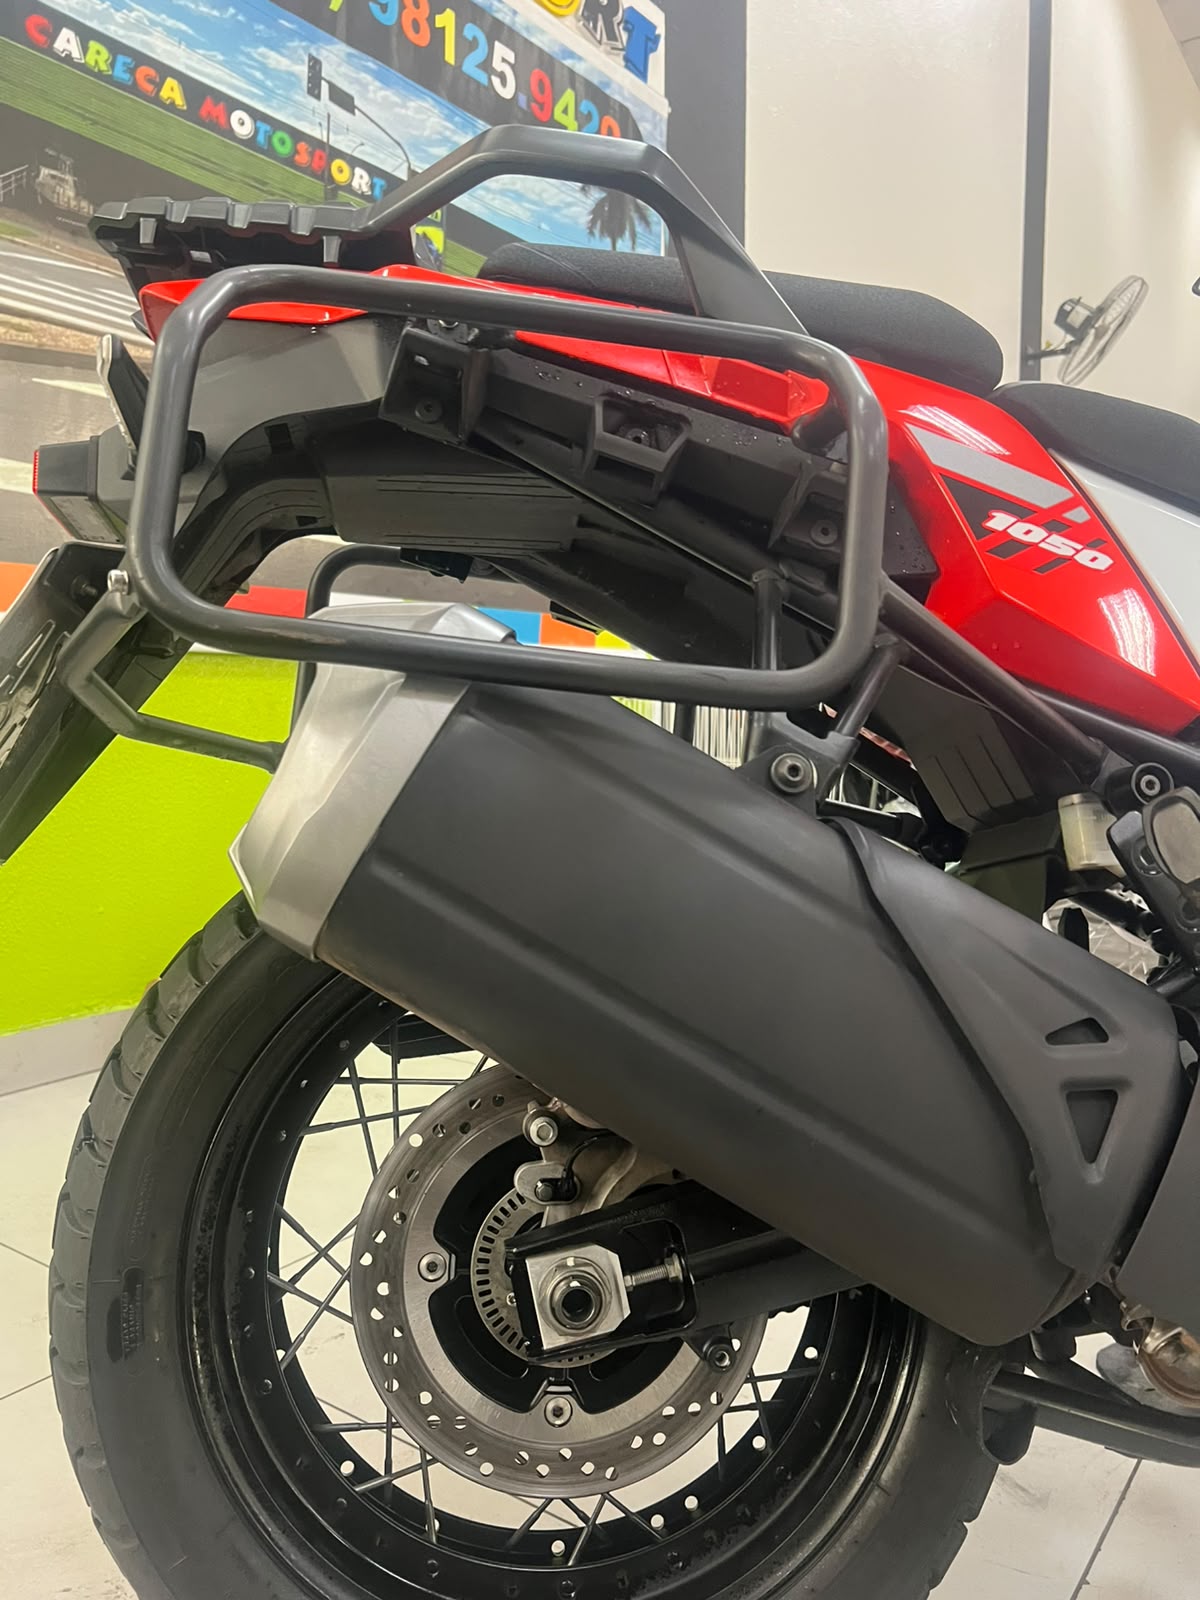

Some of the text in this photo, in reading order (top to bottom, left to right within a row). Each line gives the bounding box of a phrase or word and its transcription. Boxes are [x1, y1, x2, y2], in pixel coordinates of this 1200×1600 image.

[533, 0, 661, 84] RT
[25, 15, 387, 199] CARECA MOTOSPORT
[983, 511, 1114, 571] 1050
